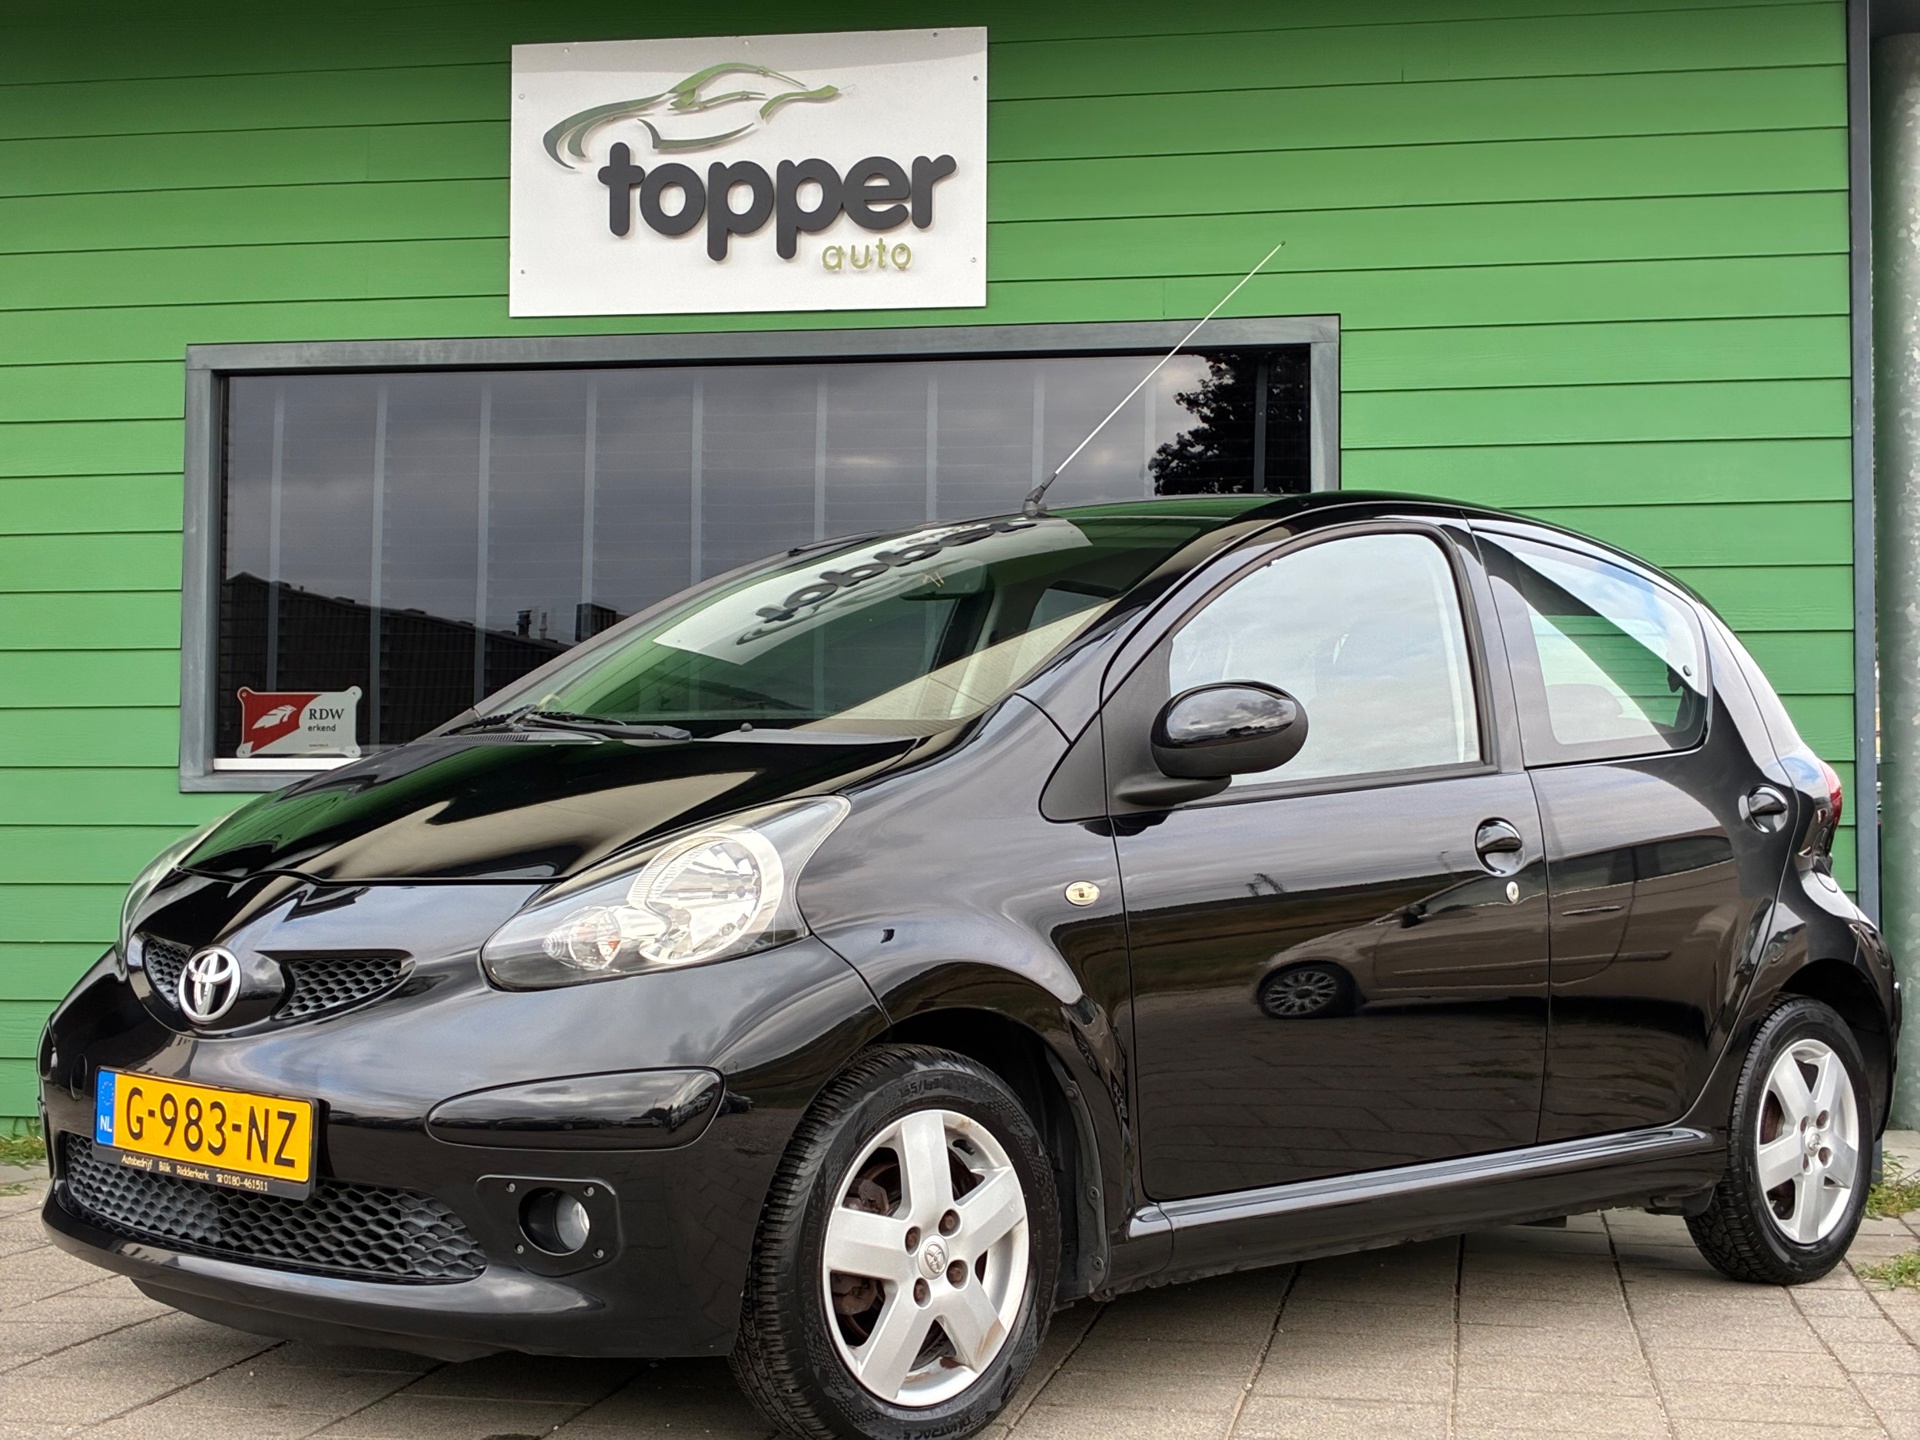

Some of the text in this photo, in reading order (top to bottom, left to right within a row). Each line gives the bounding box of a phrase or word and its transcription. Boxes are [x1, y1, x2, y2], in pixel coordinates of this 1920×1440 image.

[598, 142, 956, 261] topper
[822, 238, 911, 270] auto
[308, 708, 344, 720] RDW
[308, 724, 336, 732] erkend
[100, 1115, 112, 1132] NL
[126, 1087, 296, 1168] G-983-NZ
[121, 1154, 153, 1171] Autobedrijf
[177, 1165, 209, 1181] Ridderkerk
